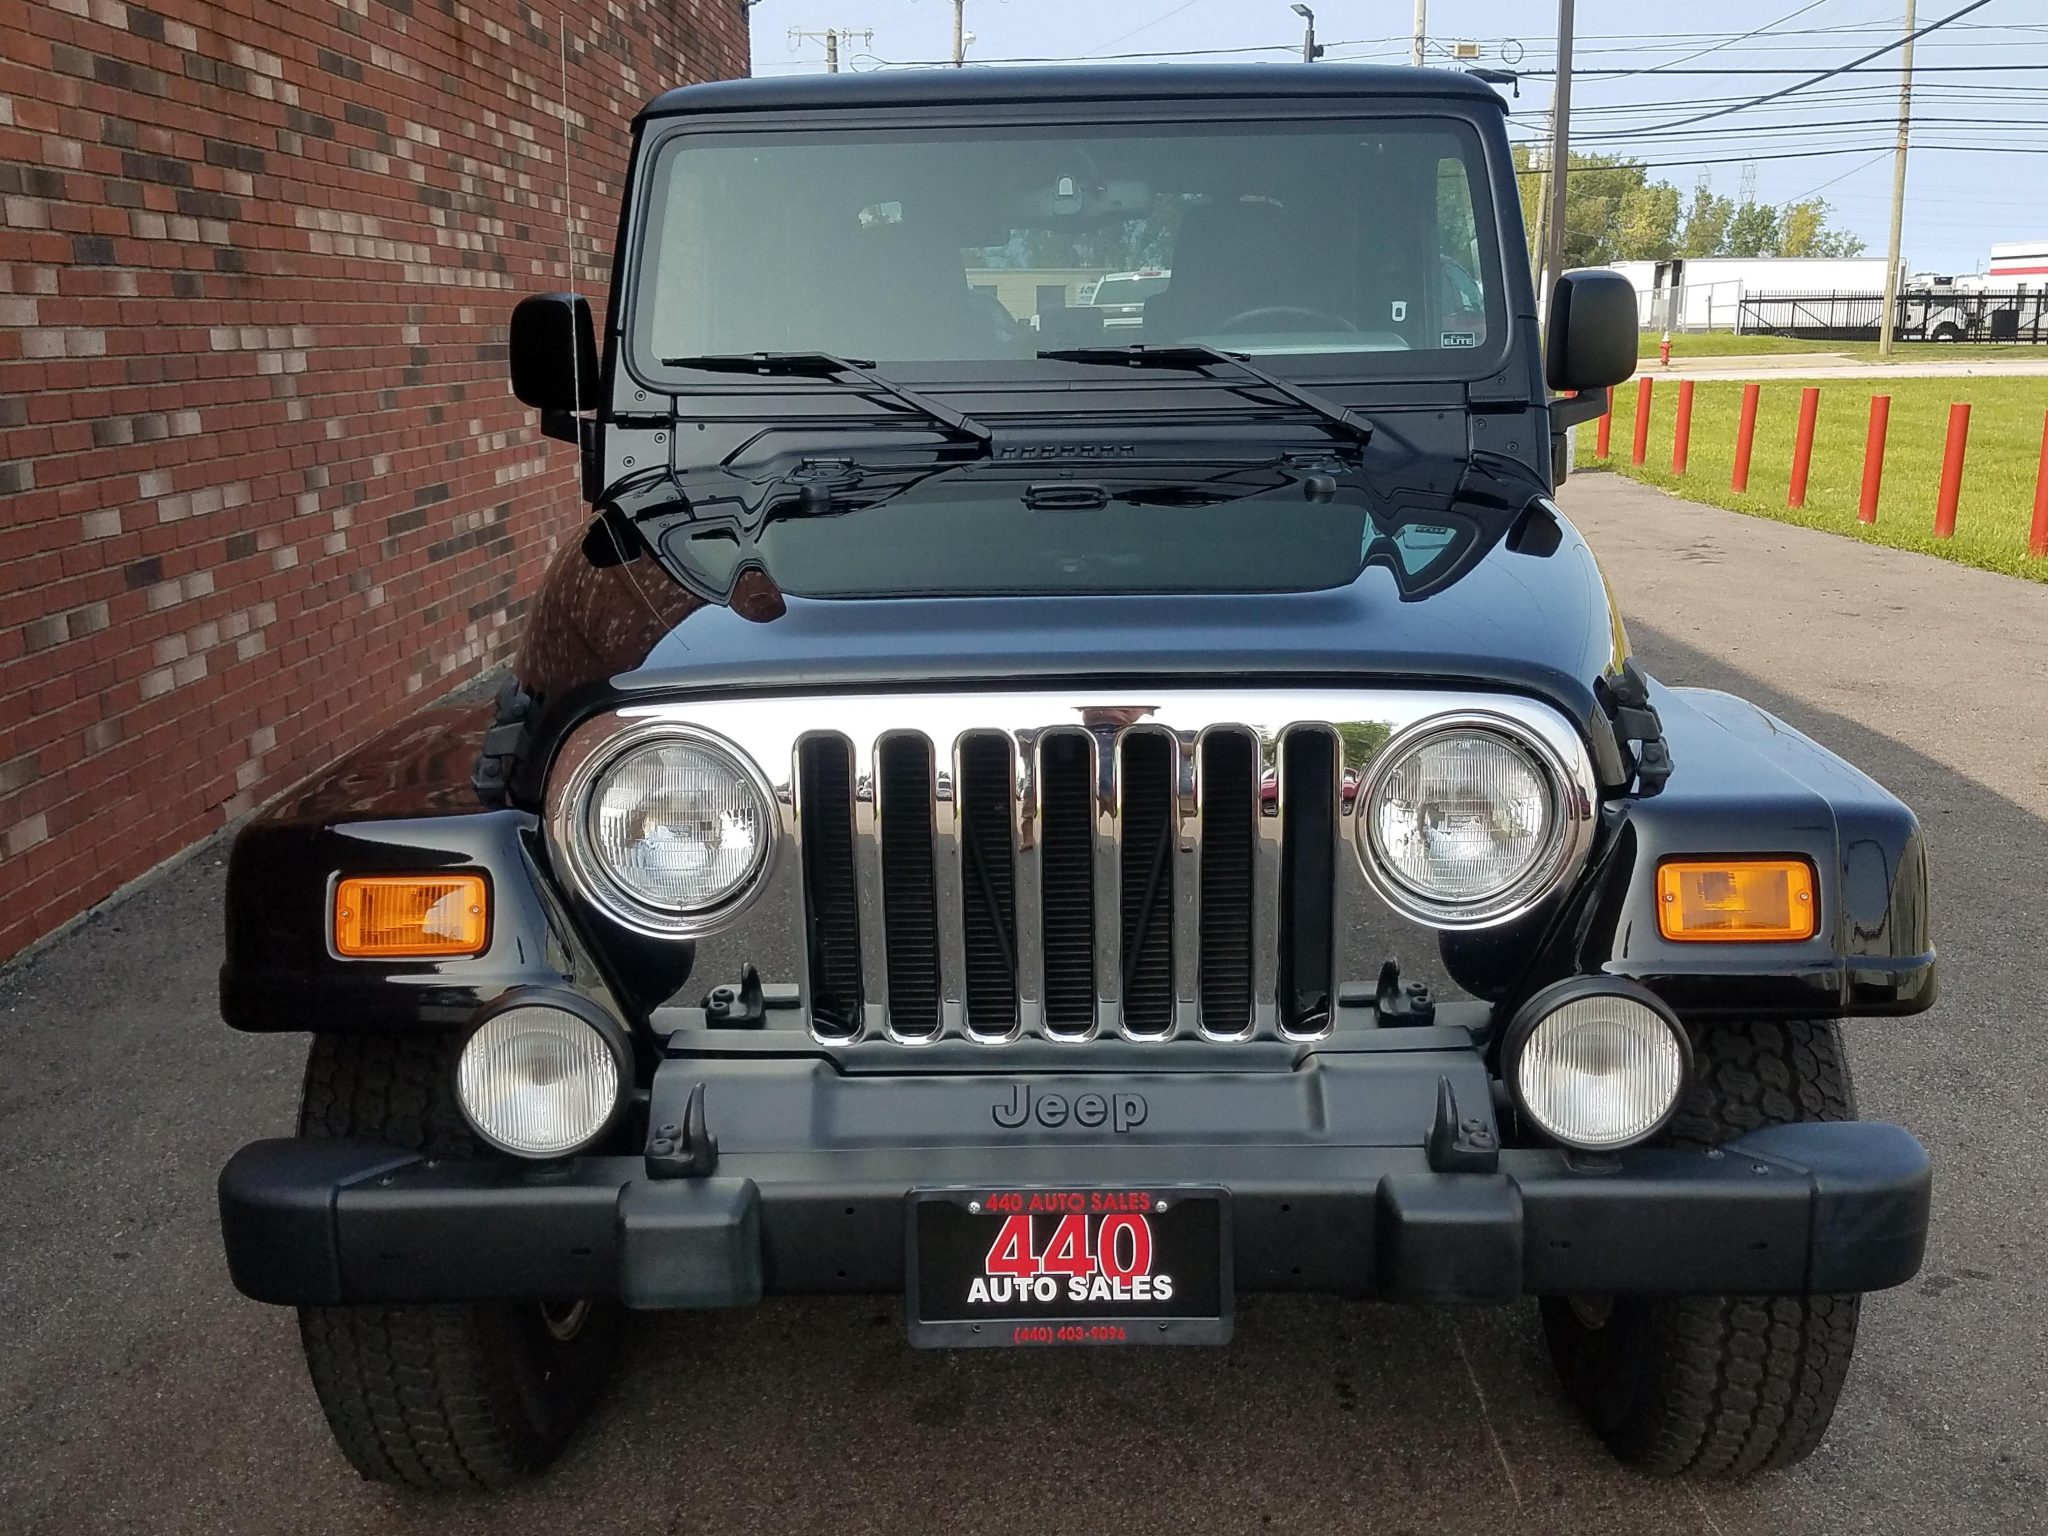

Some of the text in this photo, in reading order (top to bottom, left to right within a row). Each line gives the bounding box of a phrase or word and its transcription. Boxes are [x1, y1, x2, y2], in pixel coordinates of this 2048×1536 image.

[1444, 337, 1473, 346] ELITE
[991, 1083, 1149, 1134] Jeep
[985, 1191, 1151, 1212] 440 AUTO SALES
[985, 1213, 1153, 1289] 440
[966, 1274, 1173, 1303] AUTO SALES
[1013, 1326, 1054, 1344] (440)
